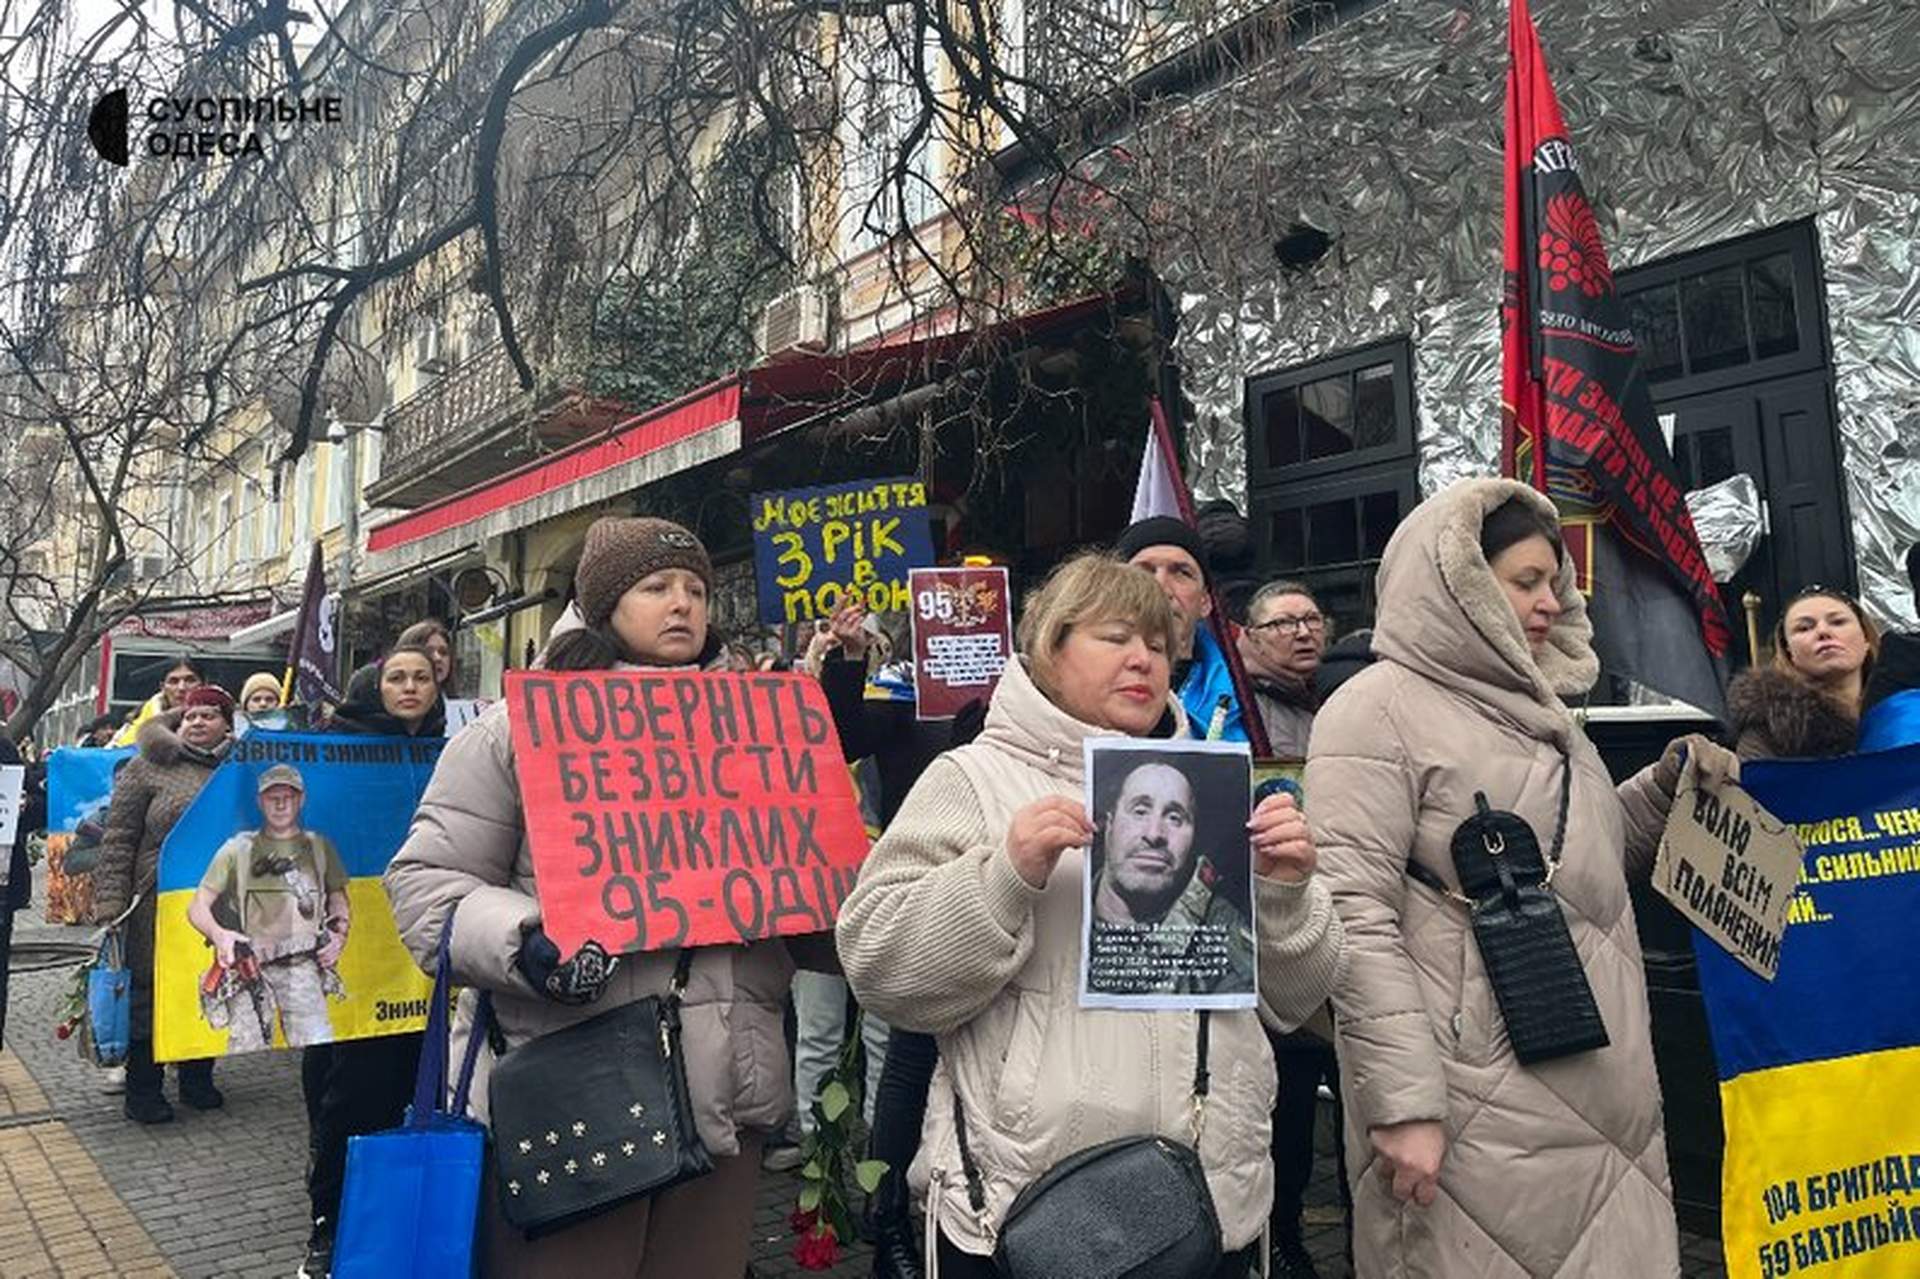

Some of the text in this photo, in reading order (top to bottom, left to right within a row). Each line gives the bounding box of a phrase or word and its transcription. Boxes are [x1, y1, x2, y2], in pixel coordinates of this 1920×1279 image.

[825, 482, 927, 518] ЖИТТЯ
[918, 591, 953, 620] 95
[523, 677, 829, 748] ПОВЕРНІТЬ
[224, 738, 318, 765] ЗВІСТИ
[558, 743, 819, 802] БЕЗВІСТИ
[571, 805, 829, 877] ЗНИКЛИХ
[1762, 1179, 1802, 1225] 104
[1759, 1239, 1791, 1279] 59
